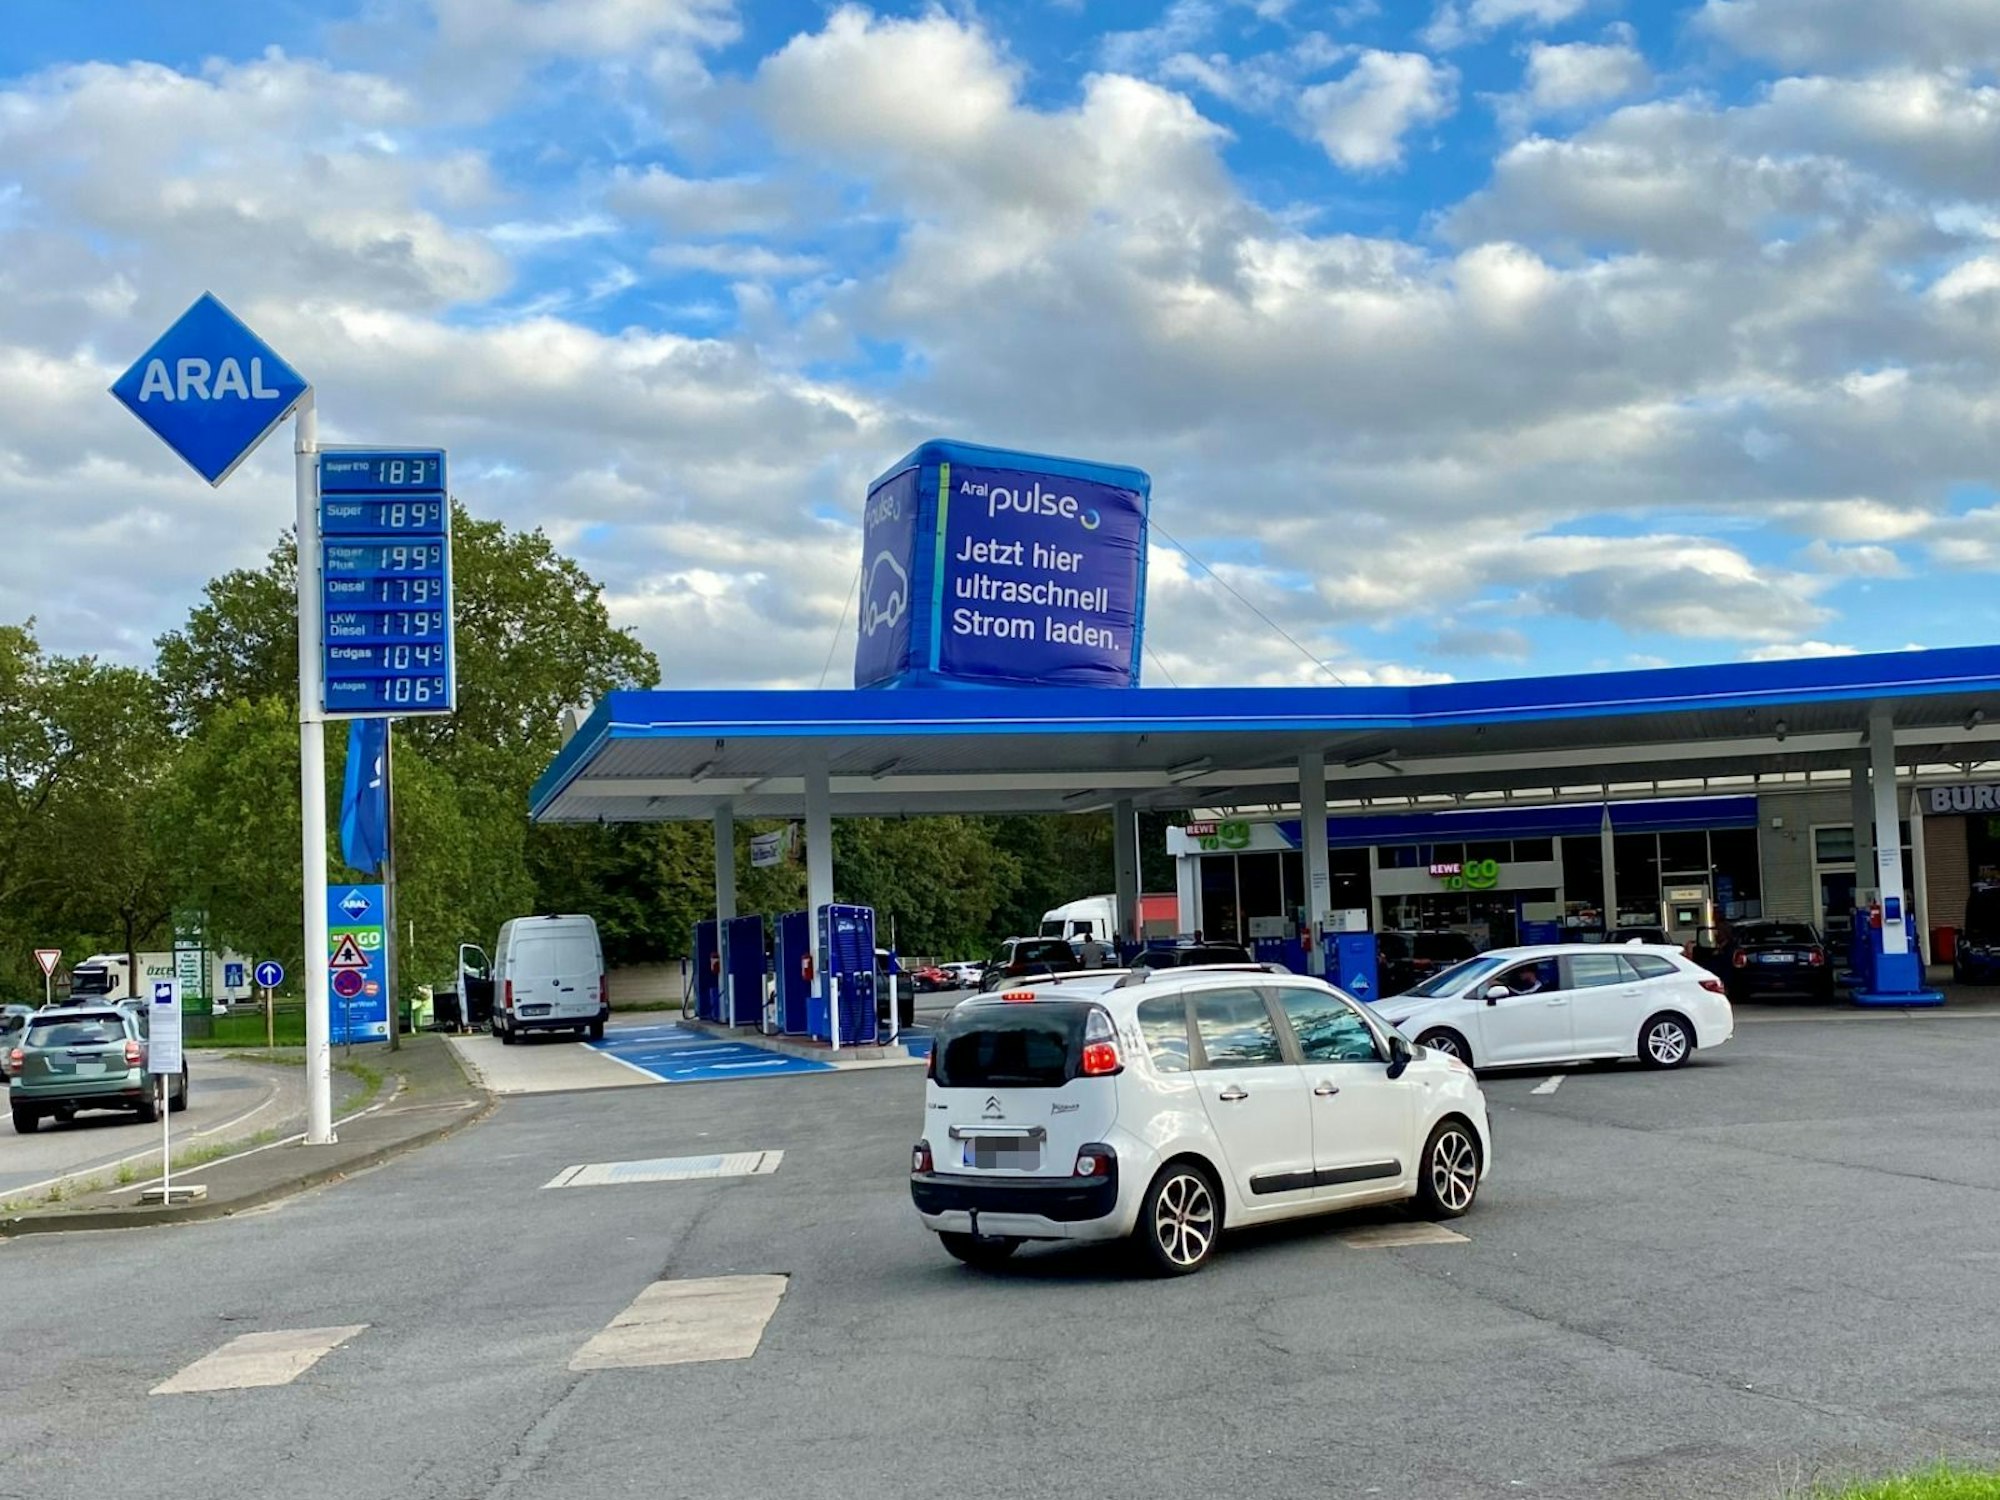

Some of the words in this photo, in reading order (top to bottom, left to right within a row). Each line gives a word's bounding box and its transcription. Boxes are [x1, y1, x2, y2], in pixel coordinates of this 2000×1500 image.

[139, 357, 280, 402] ARAL
[353, 461, 369, 470] E10
[960, 481, 988, 497] Aral
[989, 482, 1079, 518] pulse
[327, 504, 362, 518] Super
[328, 547, 363, 559] Super
[956, 536, 1024, 566] Jetzt
[1033, 541, 1084, 573] hier
[328, 580, 365, 592] Diesel
[955, 574, 1109, 614] ultraschnell
[330, 613, 356, 623] LKW
[330, 624, 365, 636] Diesel
[952, 608, 1035, 640] Strom
[1046, 616, 1120, 651] laden.
[331, 647, 372, 660] Erdgas
[332, 681, 366, 692] Autogas
[1186, 825, 1216, 835] REWE
[1219, 819, 1250, 842] GO
[1199, 837, 1219, 850] TO
[1430, 863, 1461, 874] REWE
[1465, 859, 1498, 879] GO
[1440, 876, 1463, 889] TO
[343, 899, 368, 909] ARAL
[357, 932, 380, 945] GO
